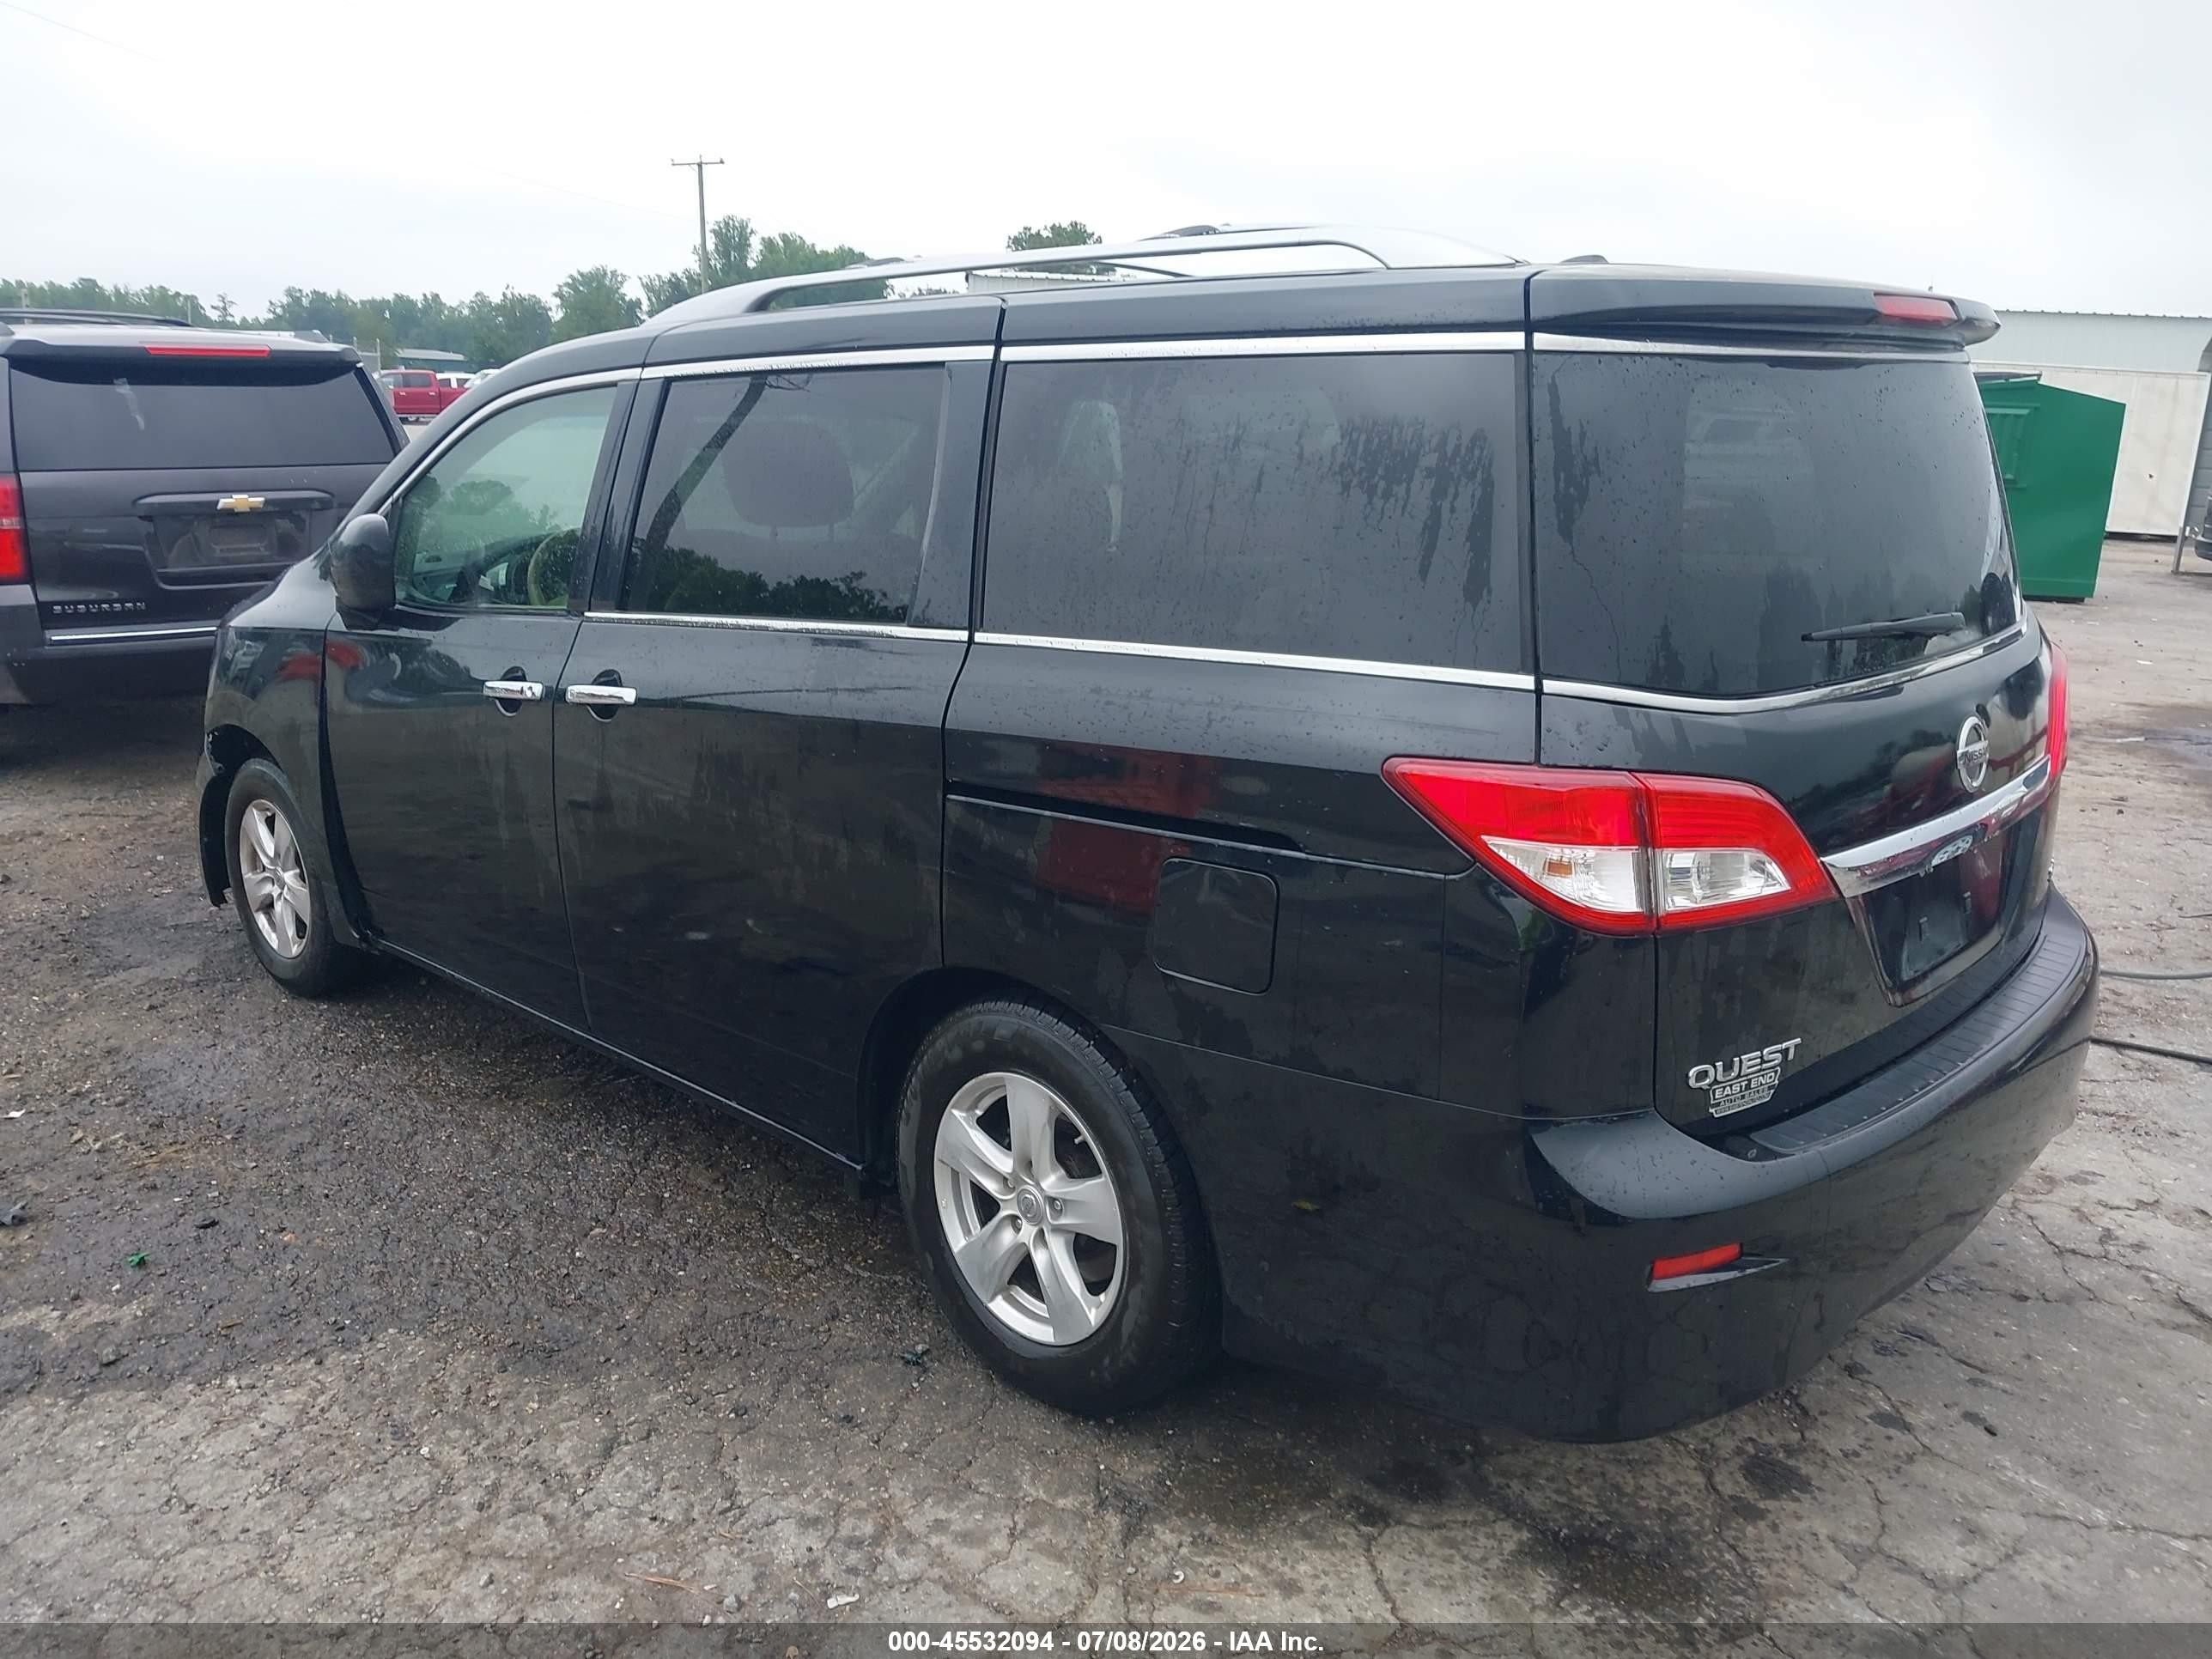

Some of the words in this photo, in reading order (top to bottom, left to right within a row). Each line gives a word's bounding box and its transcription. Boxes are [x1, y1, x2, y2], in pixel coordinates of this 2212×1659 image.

[52, 602, 146, 614] SUBURBAN
[1688, 1037, 1802, 1090] QUEST
[1715, 1080, 1748, 1099] EAST
[1750, 1072, 1776, 1088] END
